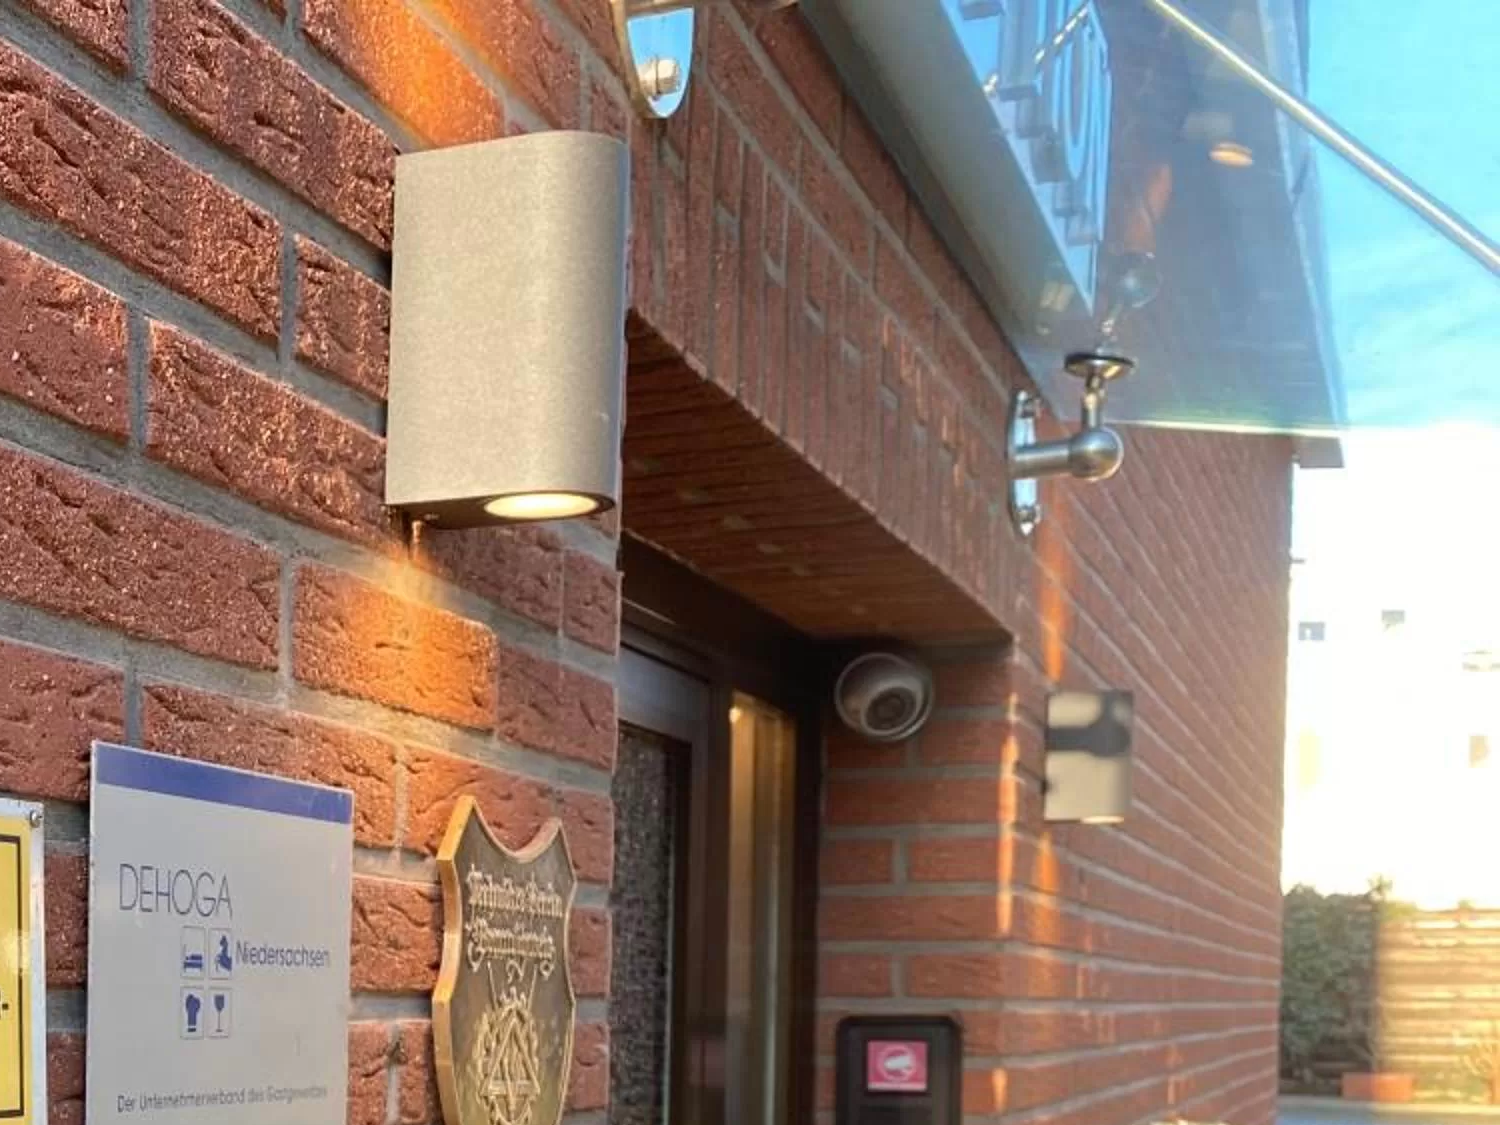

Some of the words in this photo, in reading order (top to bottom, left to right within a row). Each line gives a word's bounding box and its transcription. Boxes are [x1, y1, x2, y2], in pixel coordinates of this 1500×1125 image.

[119, 863, 233, 920] DEHOGA
[236, 938, 331, 968] Niedersachsen
[117, 1095, 135, 1113] Der
